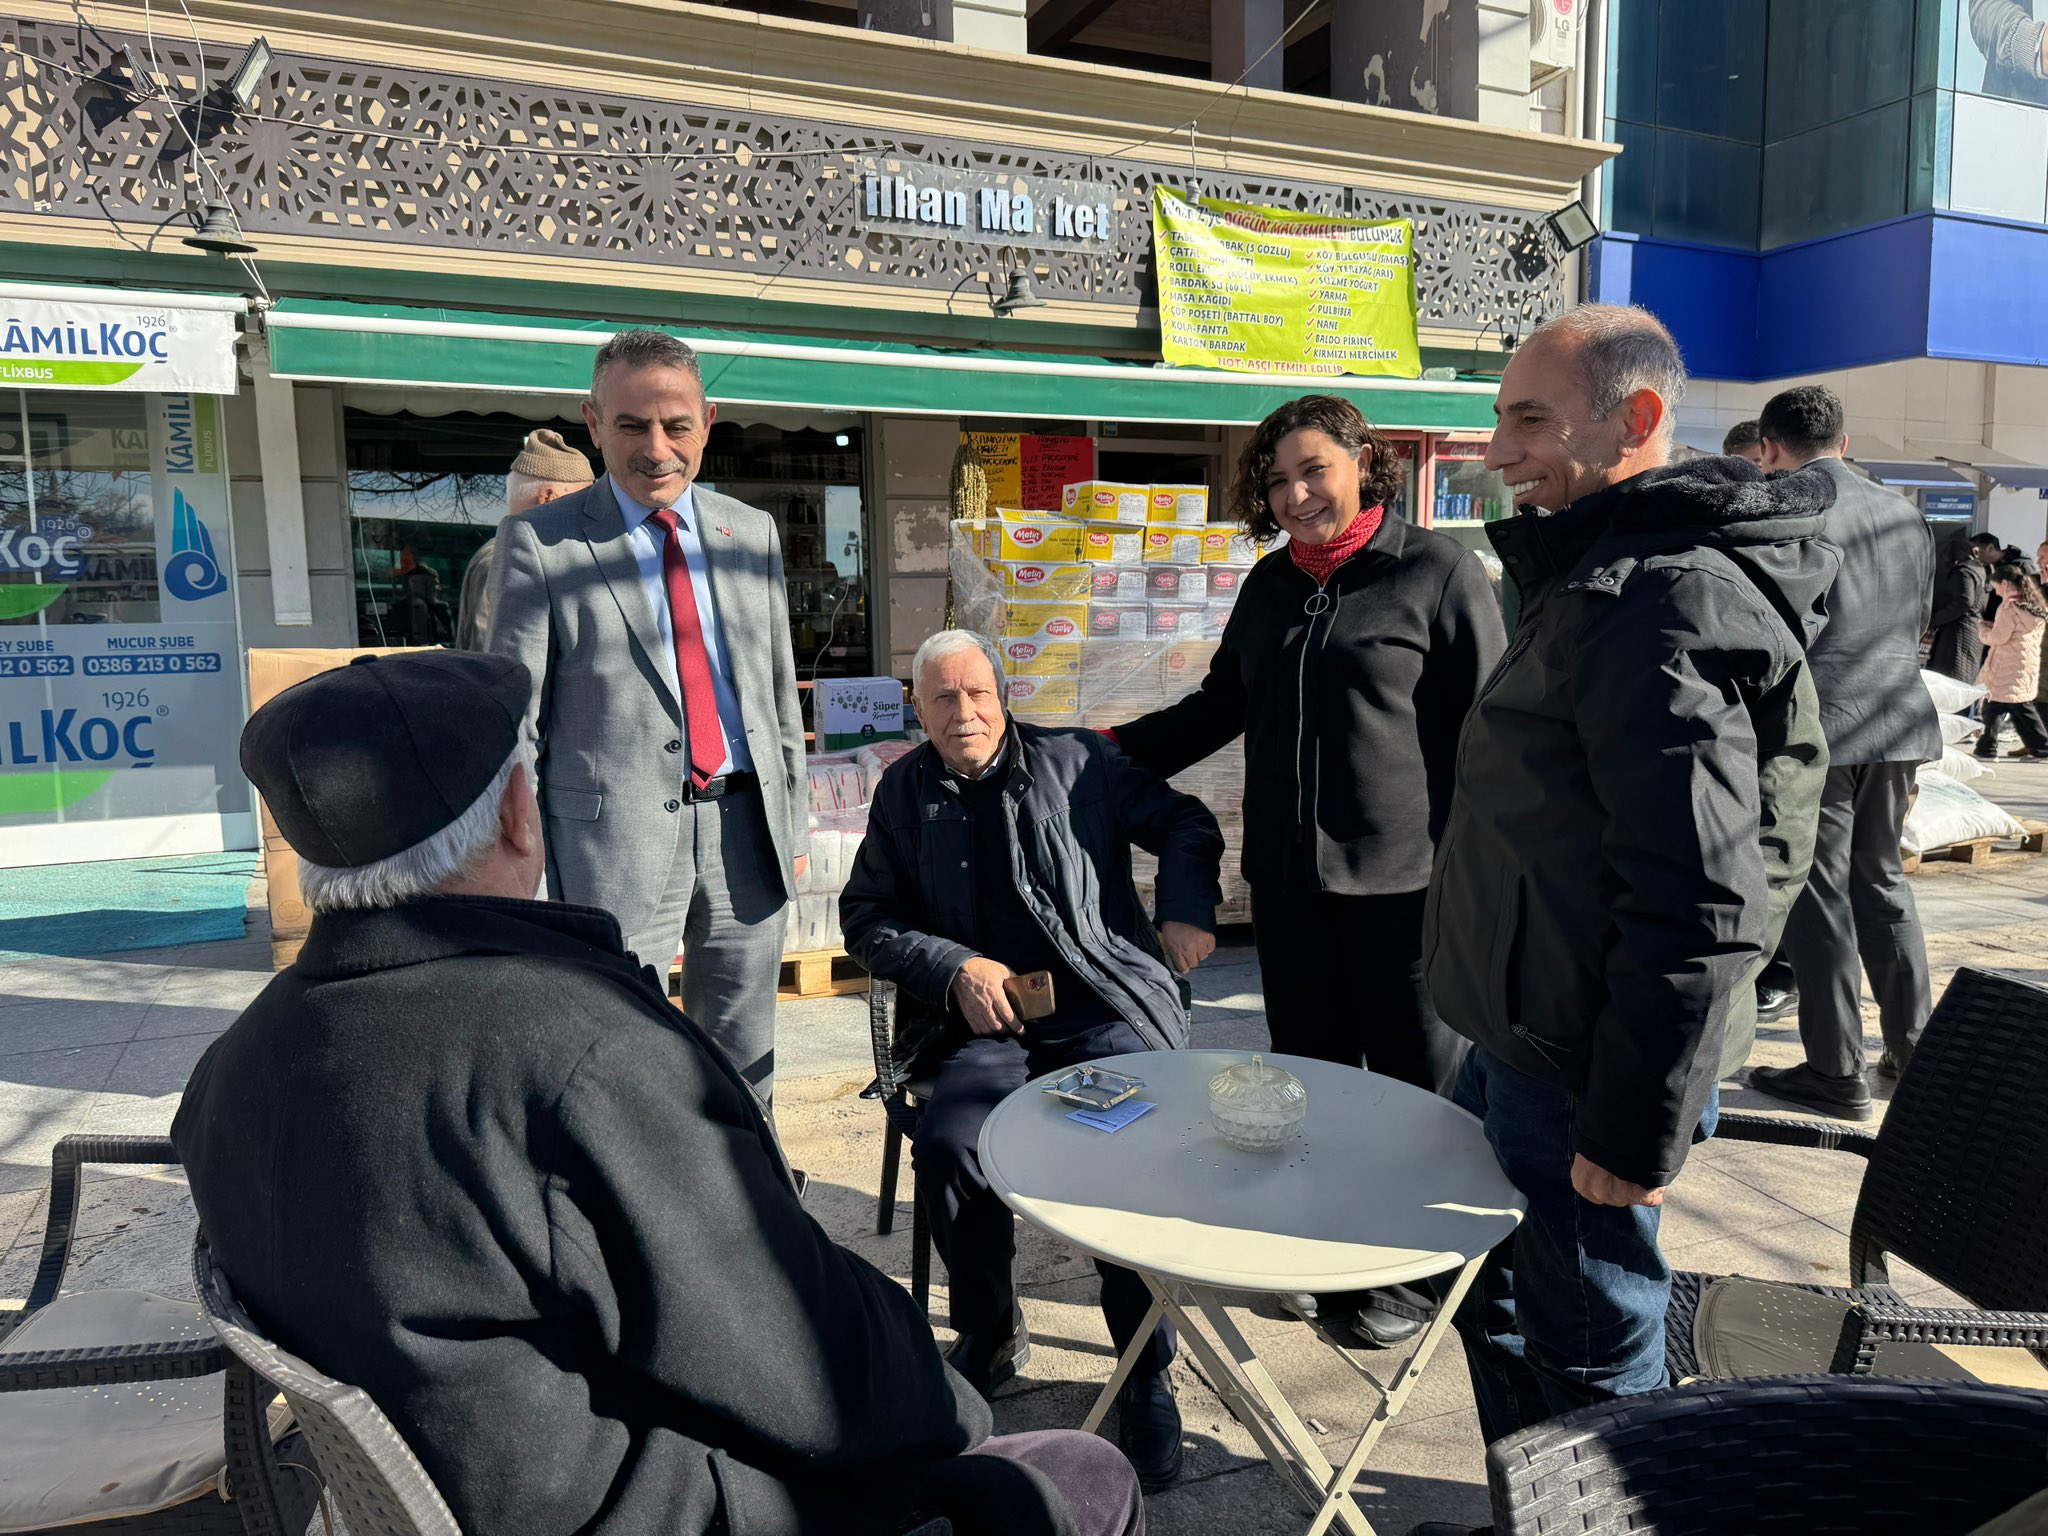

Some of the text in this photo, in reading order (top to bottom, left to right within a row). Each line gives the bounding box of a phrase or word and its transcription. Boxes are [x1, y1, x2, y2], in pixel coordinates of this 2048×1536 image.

[1555, 17, 1570, 31] LG
[1317, 250, 1333, 260] KÖY
[1169, 262, 1194, 273] ROLL
[1316, 264, 1334, 273] KÖY
[1169, 276, 1208, 289] BARDAK
[1211, 280, 1223, 290] SU
[1350, 279, 1378, 291] YOĞURT
[1170, 292, 1231, 306] MASA KAĞIDI
[1319, 290, 1347, 301] YARMA
[1170, 305, 1283, 326] ÇÖP POŞETİ (BATTAL BOY)
[1318, 304, 1352, 317] PULBİBER
[136, 315, 166, 328] 1926
[1316, 319, 1338, 330] NANE
[1172, 334, 1246, 352] KARTON BARDAK
[1315, 334, 1373, 347] BALDO PİRİNÇ
[1313, 348, 1397, 360] KIRMIZI MERCİMEK
[1218, 357, 1343, 374] NOT: AŞÇI TEMİN EDİLİR
[41, 518, 76, 532] 1926
[1015, 528, 1041, 543] Metin
[1017, 568, 1042, 581] Metin
[17, 640, 54, 653] ŞUBE
[107, 636, 195, 649] MUCUR ŞUBE
[19, 660, 31, 674] 0
[36, 659, 70, 674] 562
[88, 655, 217, 673] 0386 213 0 562
[102, 688, 150, 711] 1926
[873, 701, 900, 712] Süper
